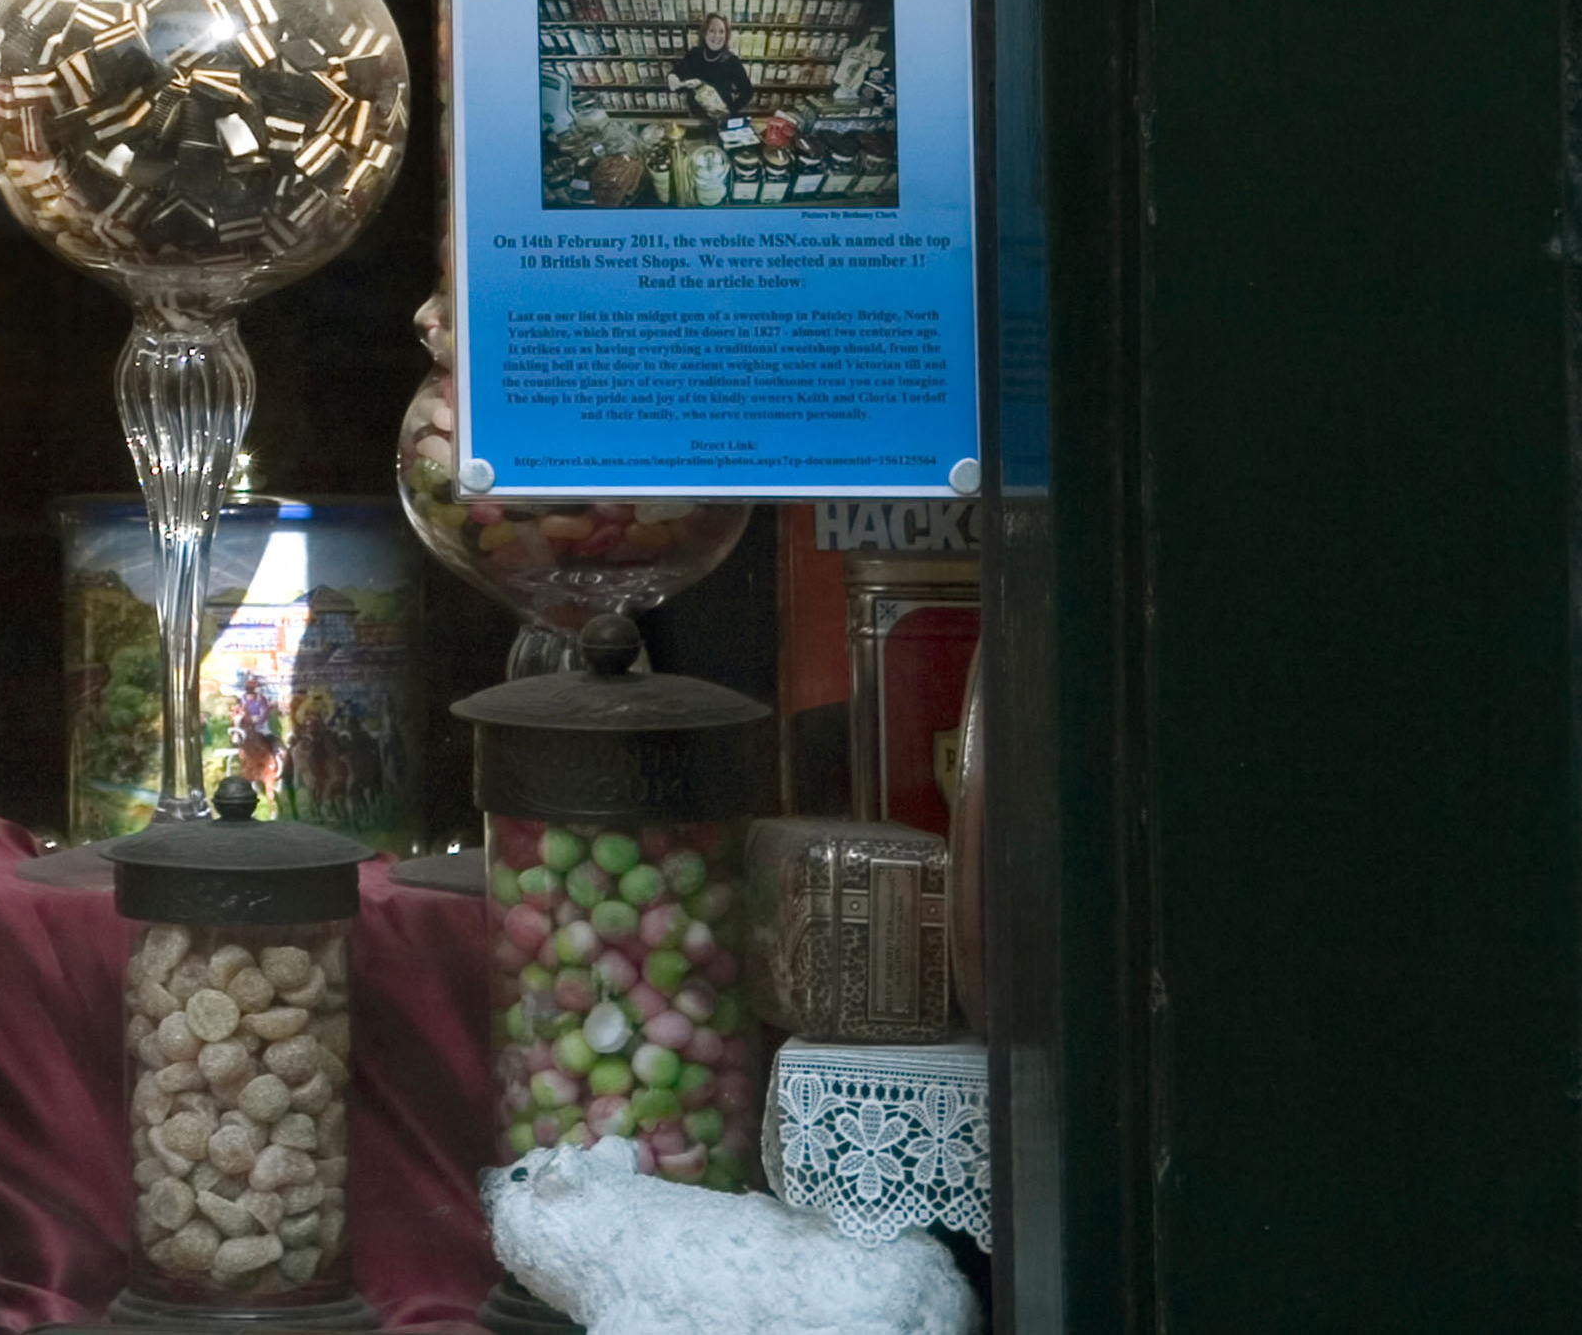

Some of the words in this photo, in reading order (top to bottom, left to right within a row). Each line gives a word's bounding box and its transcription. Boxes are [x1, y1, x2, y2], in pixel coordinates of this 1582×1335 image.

[493, 234, 516, 248] On
[522, 234, 552, 248] 14th
[558, 234, 625, 252] February
[631, 234, 668, 252] 2011,
[674, 234, 696, 248] the
[701, 234, 755, 248] website
[759, 233, 840, 247] MSN.co.uk
[845, 233, 894, 247] named
[899, 233, 922, 247] the
[927, 233, 951, 251] top
[520, 255, 536, 268] 10
[541, 255, 590, 268] British
[595, 255, 638, 268] Sweet
[642, 255, 689, 271] Shops.
[699, 255, 723, 268] We
[728, 258, 763, 268] were
[767, 255, 824, 268] selected
[828, 258, 844, 267] as
[848, 254, 905, 267] number
[912, 254, 926, 267] 1!
[638, 275, 676, 288] Read
[680, 275, 703, 288] the
[707, 275, 754, 288] article
[758, 275, 807, 288] below:
[690, 441, 725, 450] Direct
[728, 441, 758, 450] Link:
